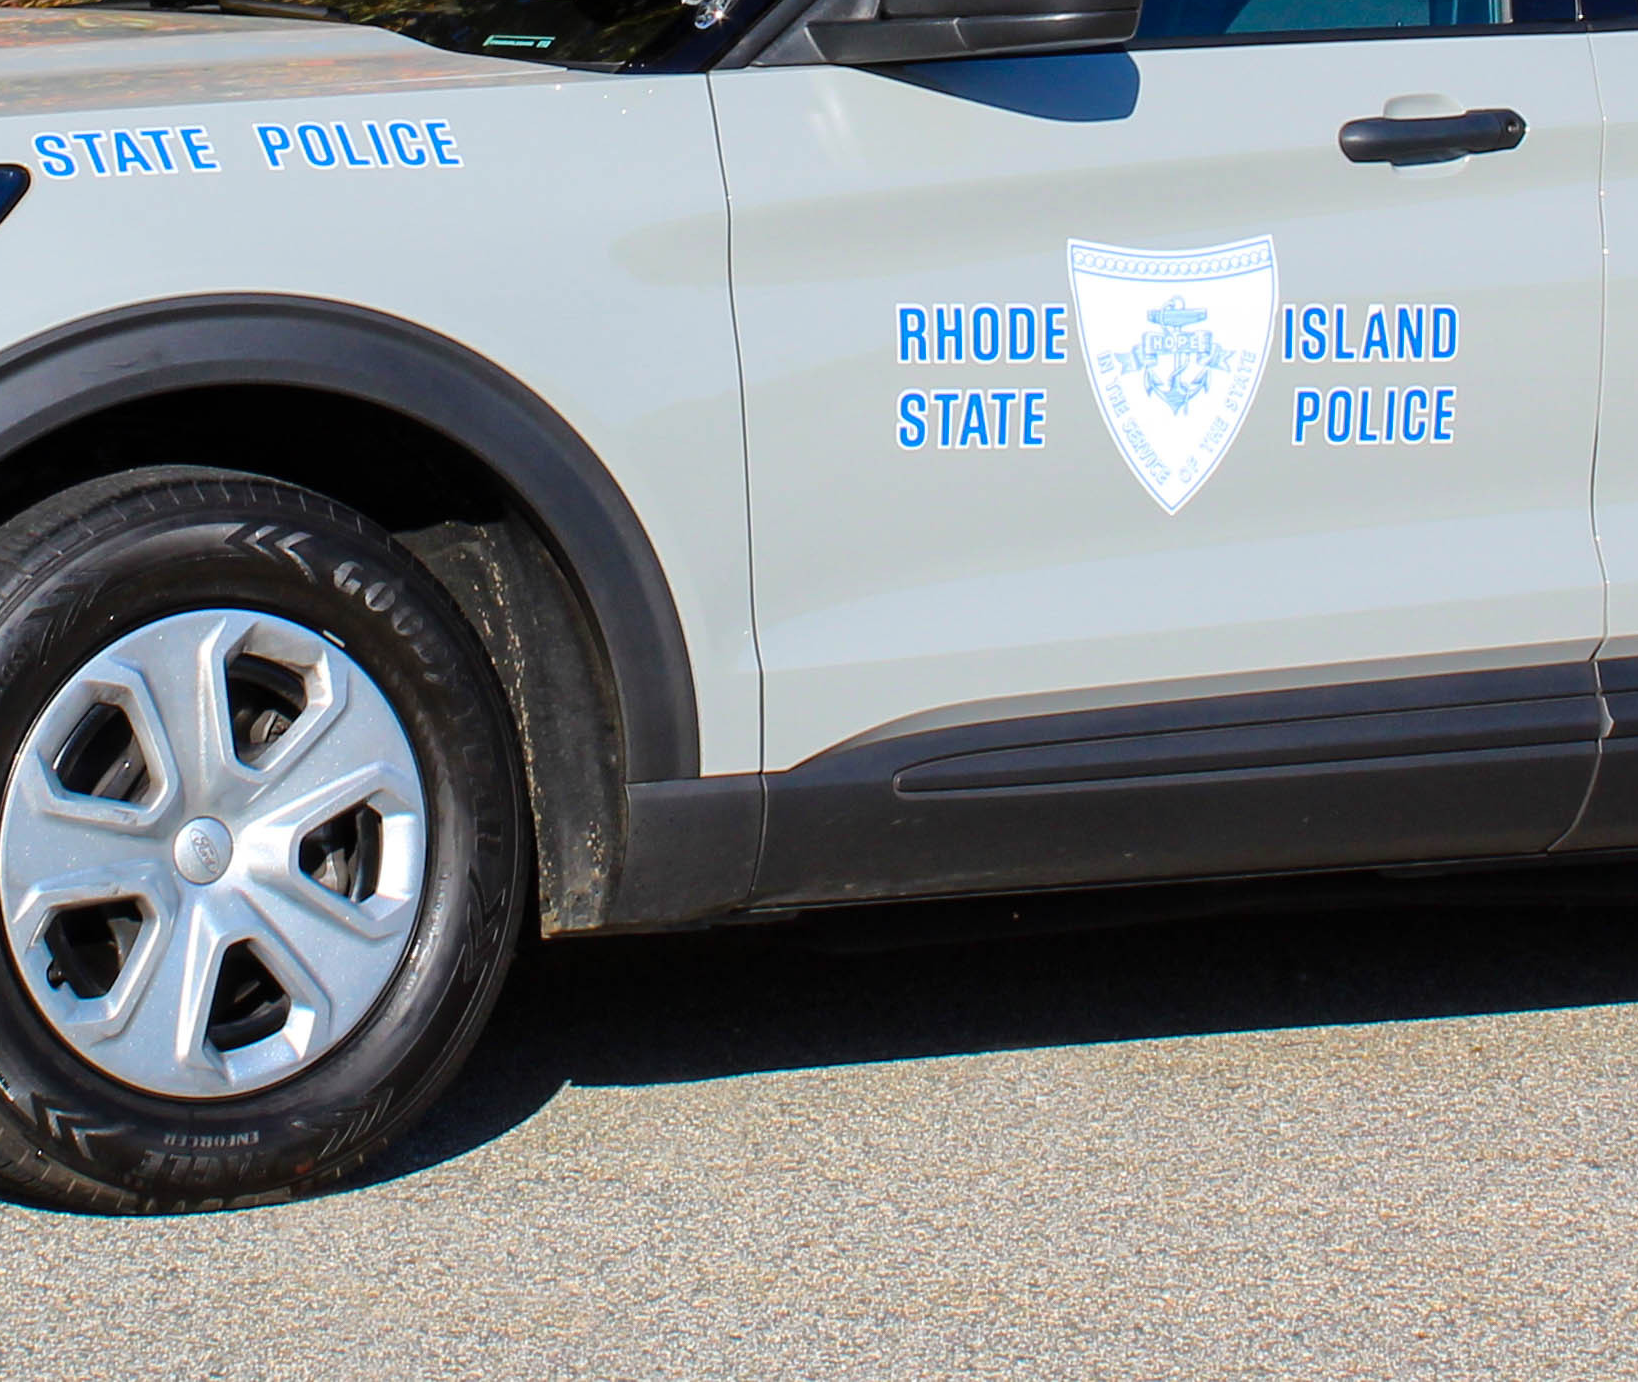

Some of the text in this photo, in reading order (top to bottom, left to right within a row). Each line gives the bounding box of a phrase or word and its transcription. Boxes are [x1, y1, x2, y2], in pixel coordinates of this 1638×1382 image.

[34, 121, 461, 178] STATE POLICE
[898, 305, 1459, 363] RHODE ISLAND
[1153, 335, 1200, 351] HOPE
[898, 388, 1456, 450] STATE POLICE
[163, 1130, 260, 1148] ENFORCER
